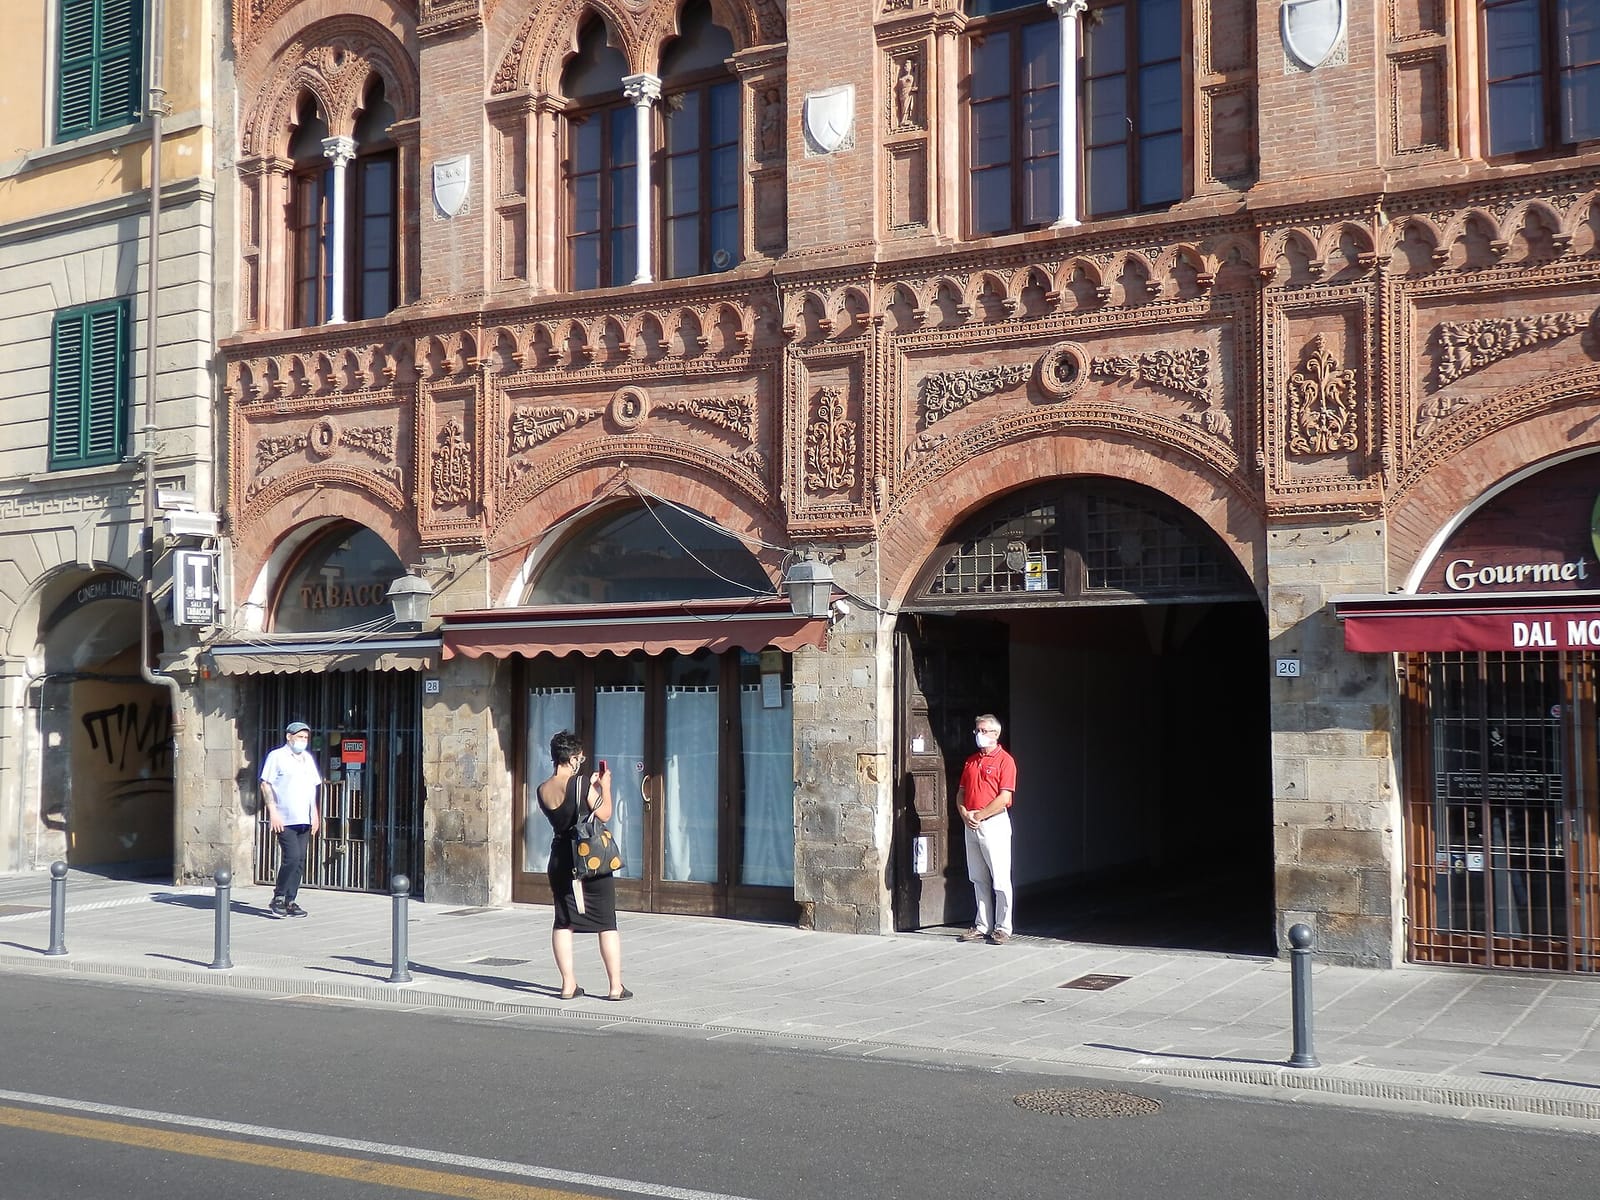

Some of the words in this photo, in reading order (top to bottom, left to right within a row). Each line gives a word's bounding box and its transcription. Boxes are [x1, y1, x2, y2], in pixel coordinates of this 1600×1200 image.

[187, 557, 208, 600] T
[1445, 557, 1588, 591] Gourmet
[77, 583, 107, 603] CINEMA
[111, 580, 143, 600] LUMIER
[1513, 621, 1557, 648] DAL
[1279, 662, 1296, 674] 26
[426, 681, 438, 691] 28
